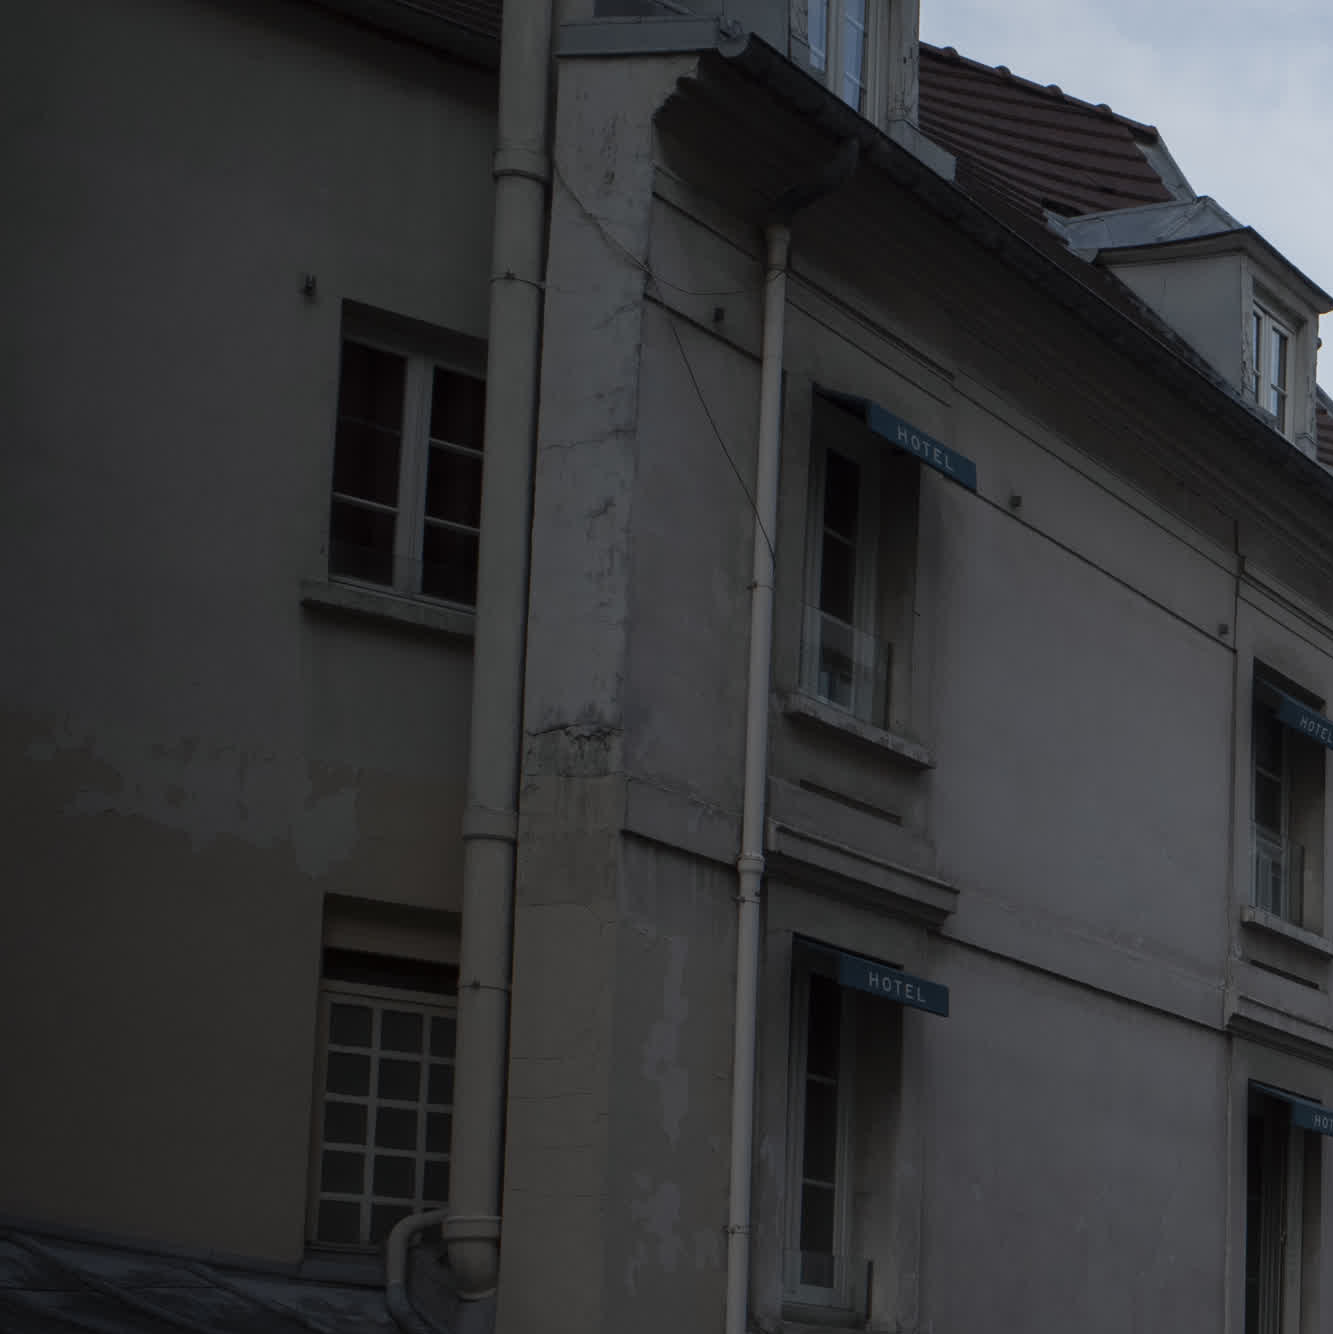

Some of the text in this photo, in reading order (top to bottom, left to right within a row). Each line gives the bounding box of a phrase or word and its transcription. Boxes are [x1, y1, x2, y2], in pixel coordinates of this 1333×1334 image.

[897, 424, 953, 472] HOTEL
[1300, 714, 1333, 744] HOTEL
[868, 971, 926, 1003] HOTEL
